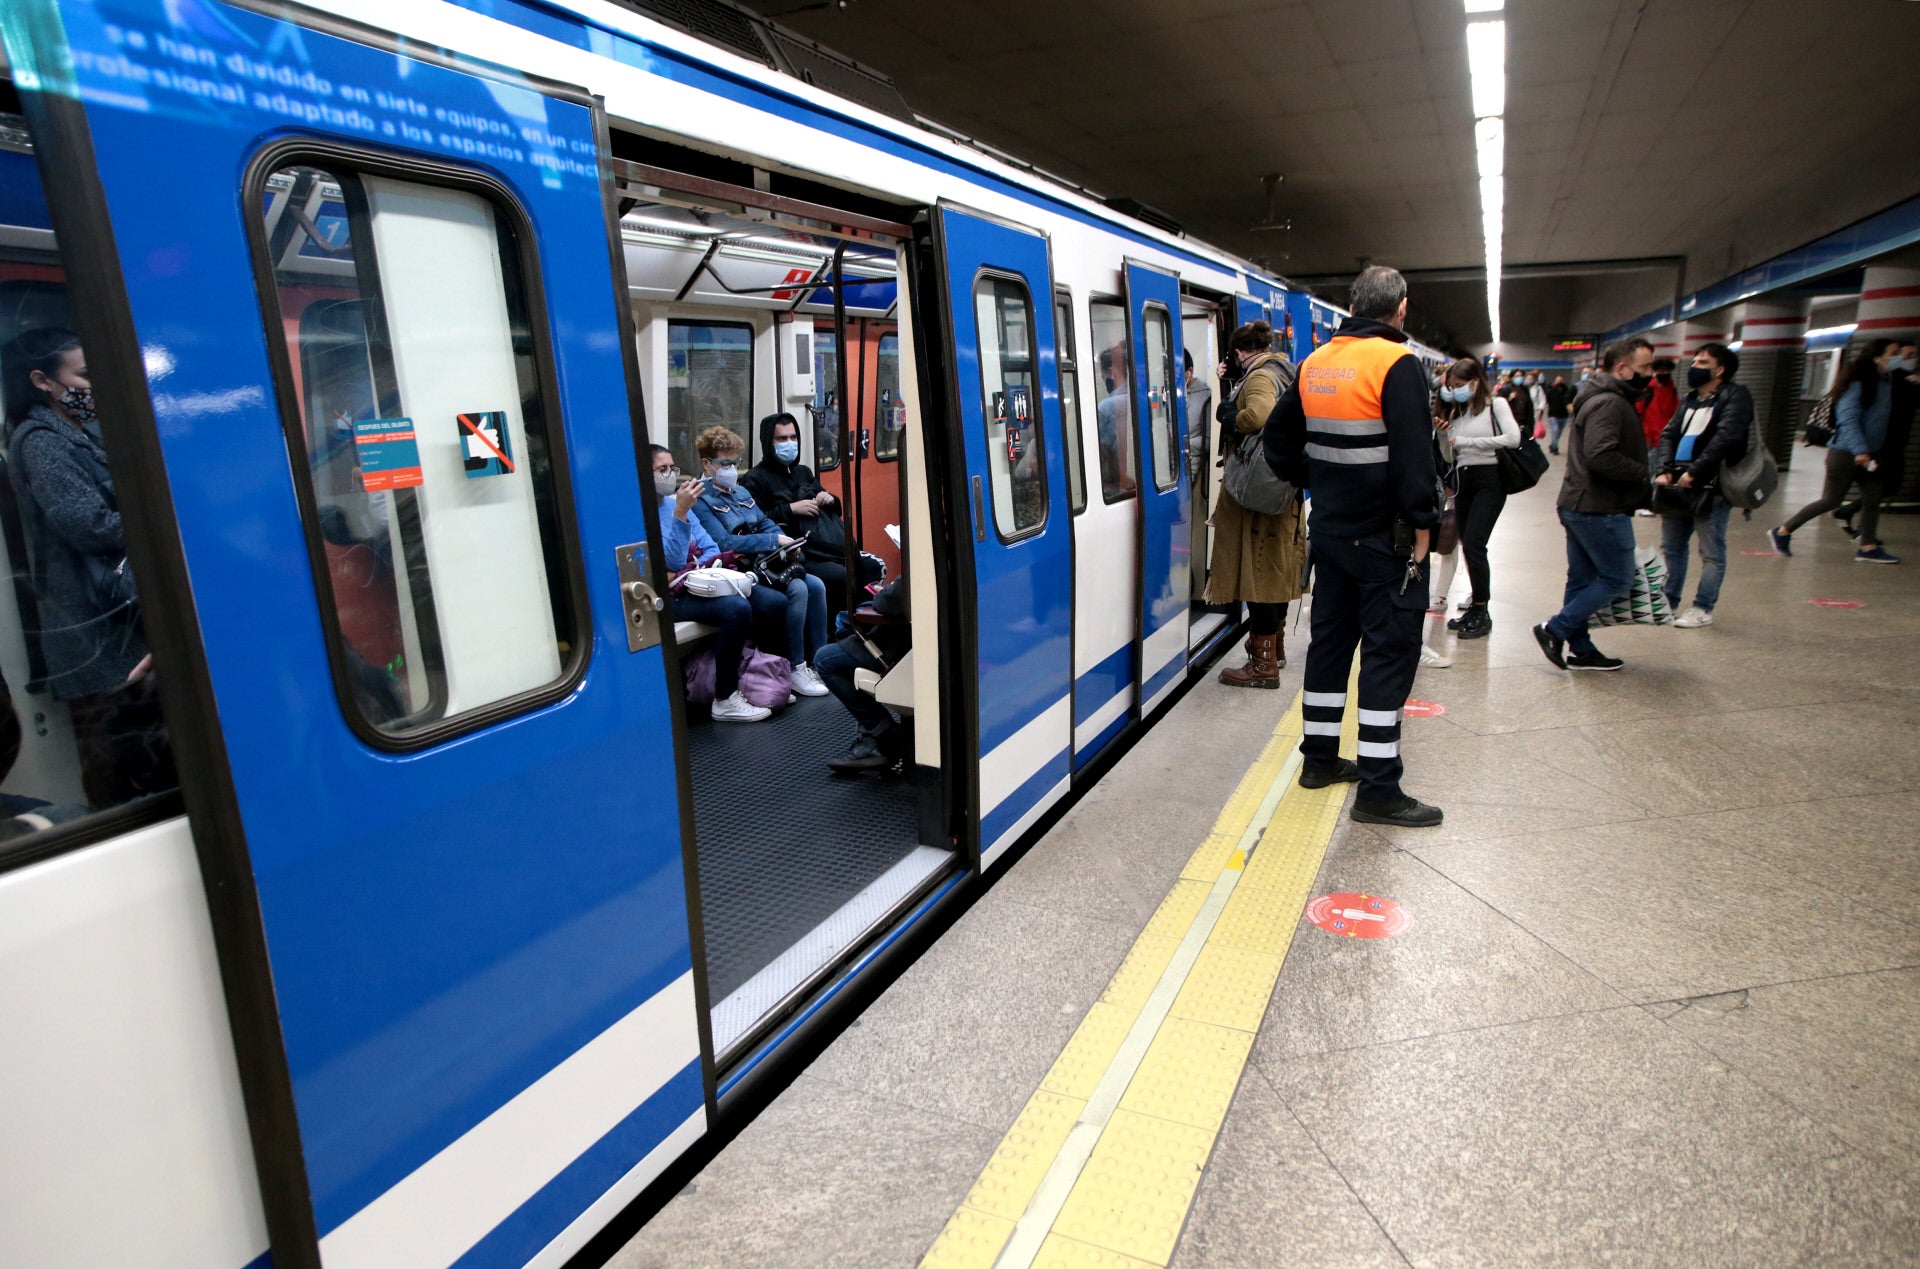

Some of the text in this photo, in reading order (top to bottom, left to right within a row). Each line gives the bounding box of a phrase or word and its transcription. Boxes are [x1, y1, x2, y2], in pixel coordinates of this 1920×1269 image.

[103, 24, 148, 50] se
[155, 32, 217, 68] han
[225, 53, 333, 95] dividido
[340, 84, 370, 104] en
[375, 92, 429, 118] siete
[435, 107, 516, 140] equipos,
[520, 126, 543, 143] en
[545, 134, 567, 150] un
[253, 92, 375, 133] adaptado
[382, 120, 396, 137] a
[401, 121, 434, 145] los
[440, 133, 524, 164] espacios
